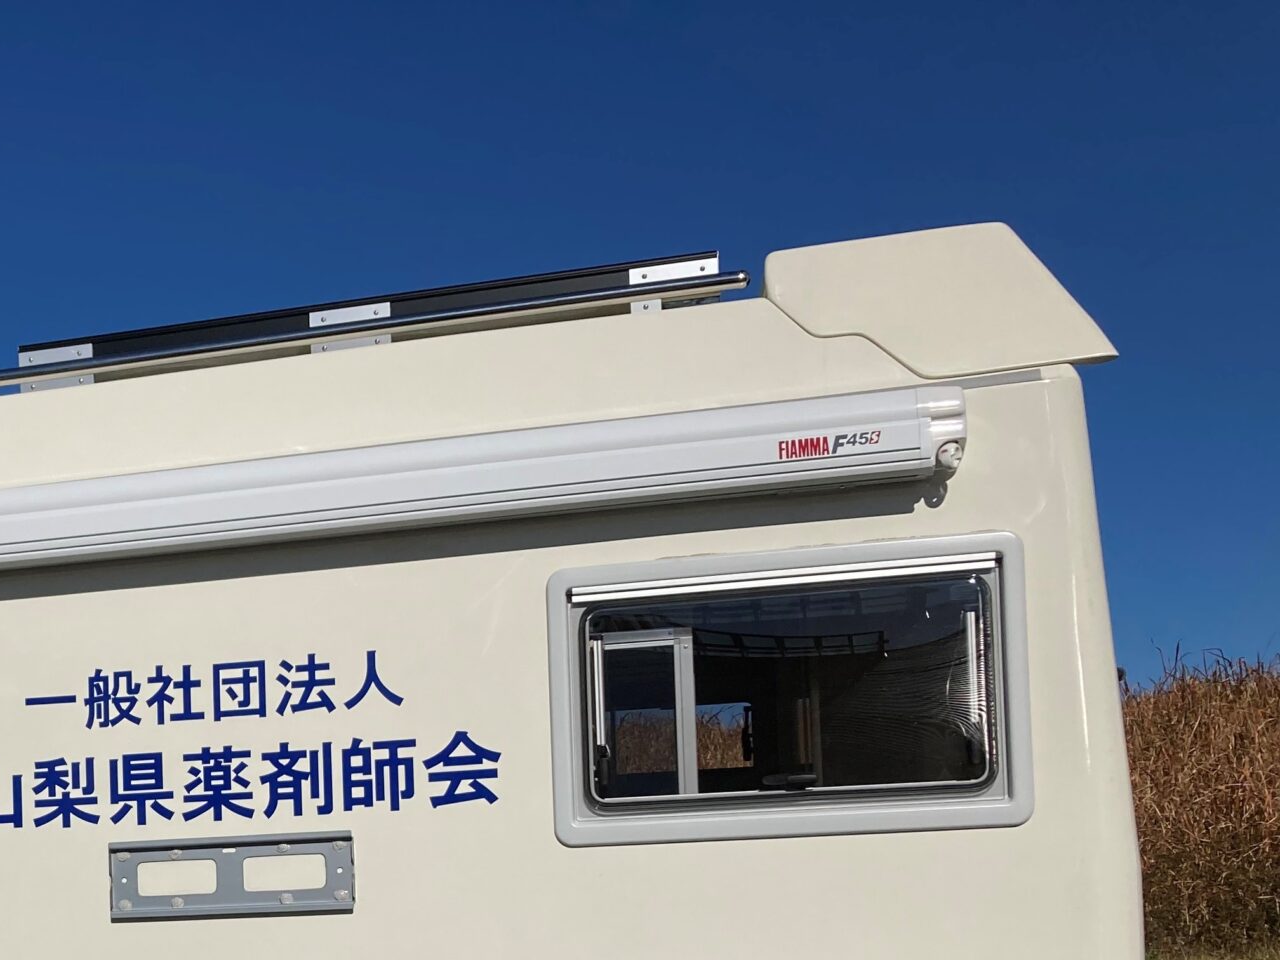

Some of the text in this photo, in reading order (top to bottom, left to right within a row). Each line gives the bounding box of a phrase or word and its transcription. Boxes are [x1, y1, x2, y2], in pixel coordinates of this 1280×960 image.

[778, 436, 830, 460] FIAMMA
[25, 650, 404, 729] 一般社団法人
